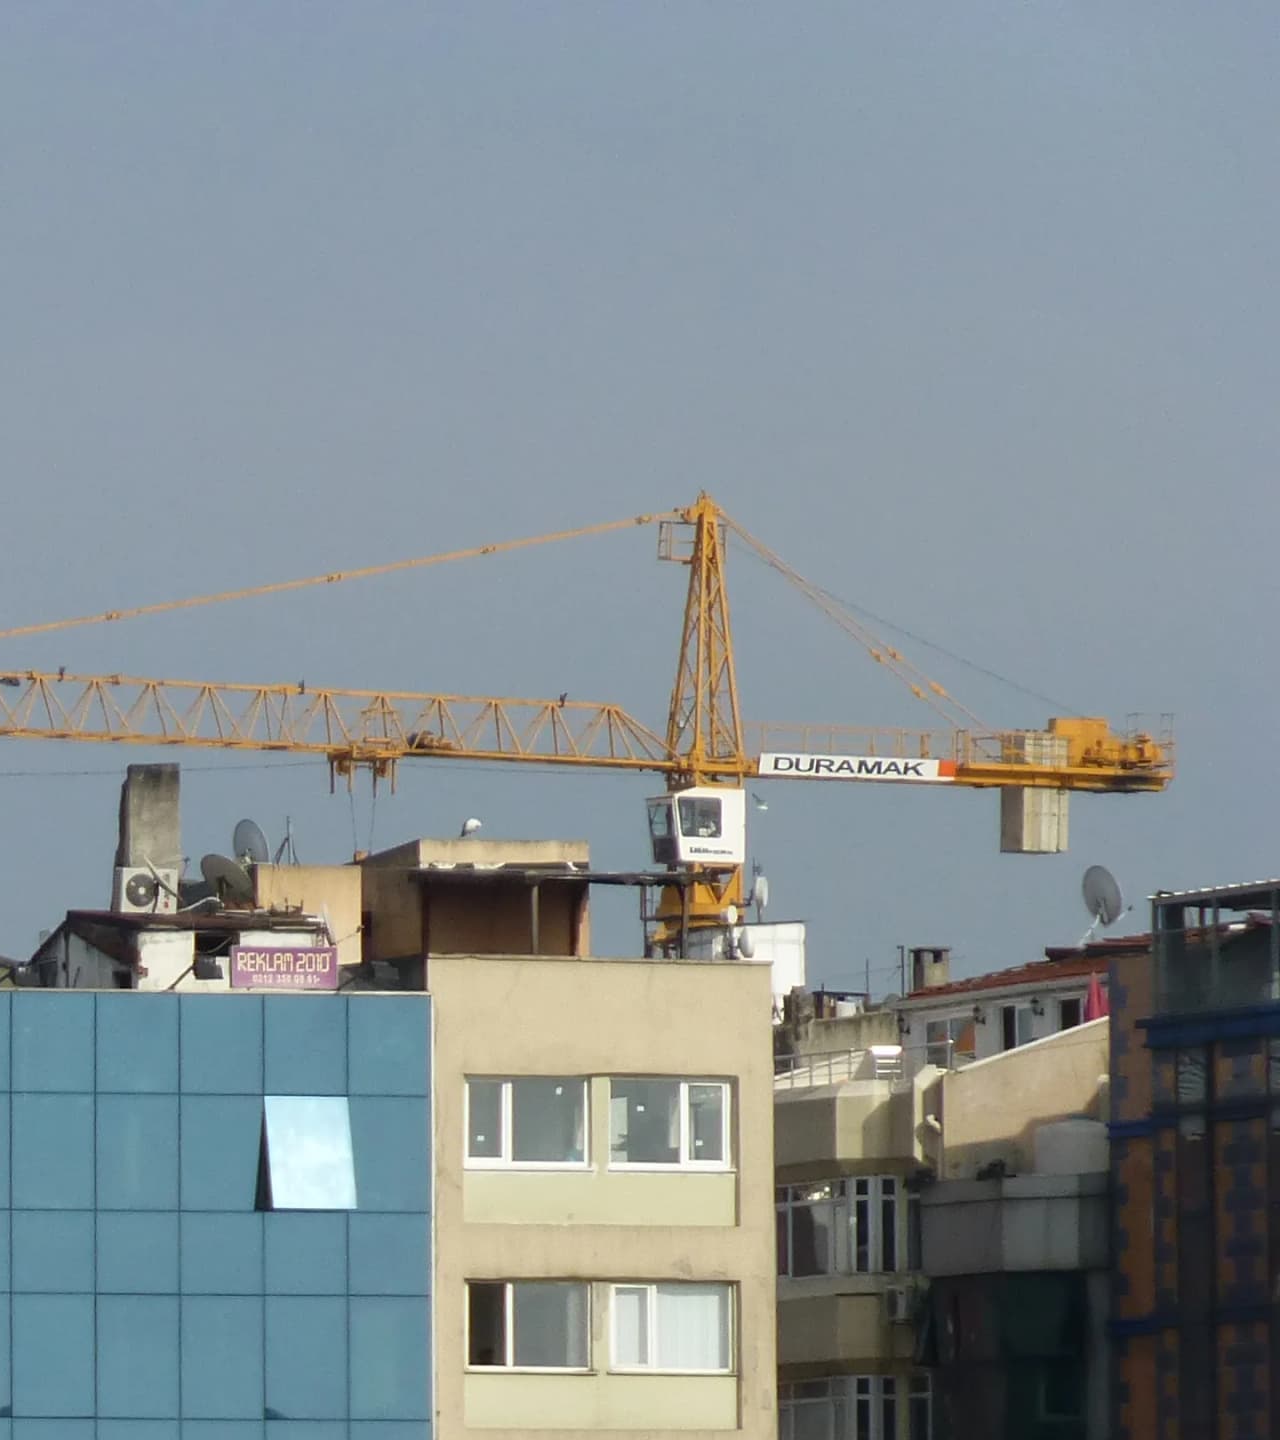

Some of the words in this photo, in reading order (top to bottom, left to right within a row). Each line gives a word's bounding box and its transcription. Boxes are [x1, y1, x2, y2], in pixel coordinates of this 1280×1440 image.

[773, 756, 924, 776] DURAMAK
[236, 952, 293, 973] REKLAM
[295, 952, 330, 973] 2010
